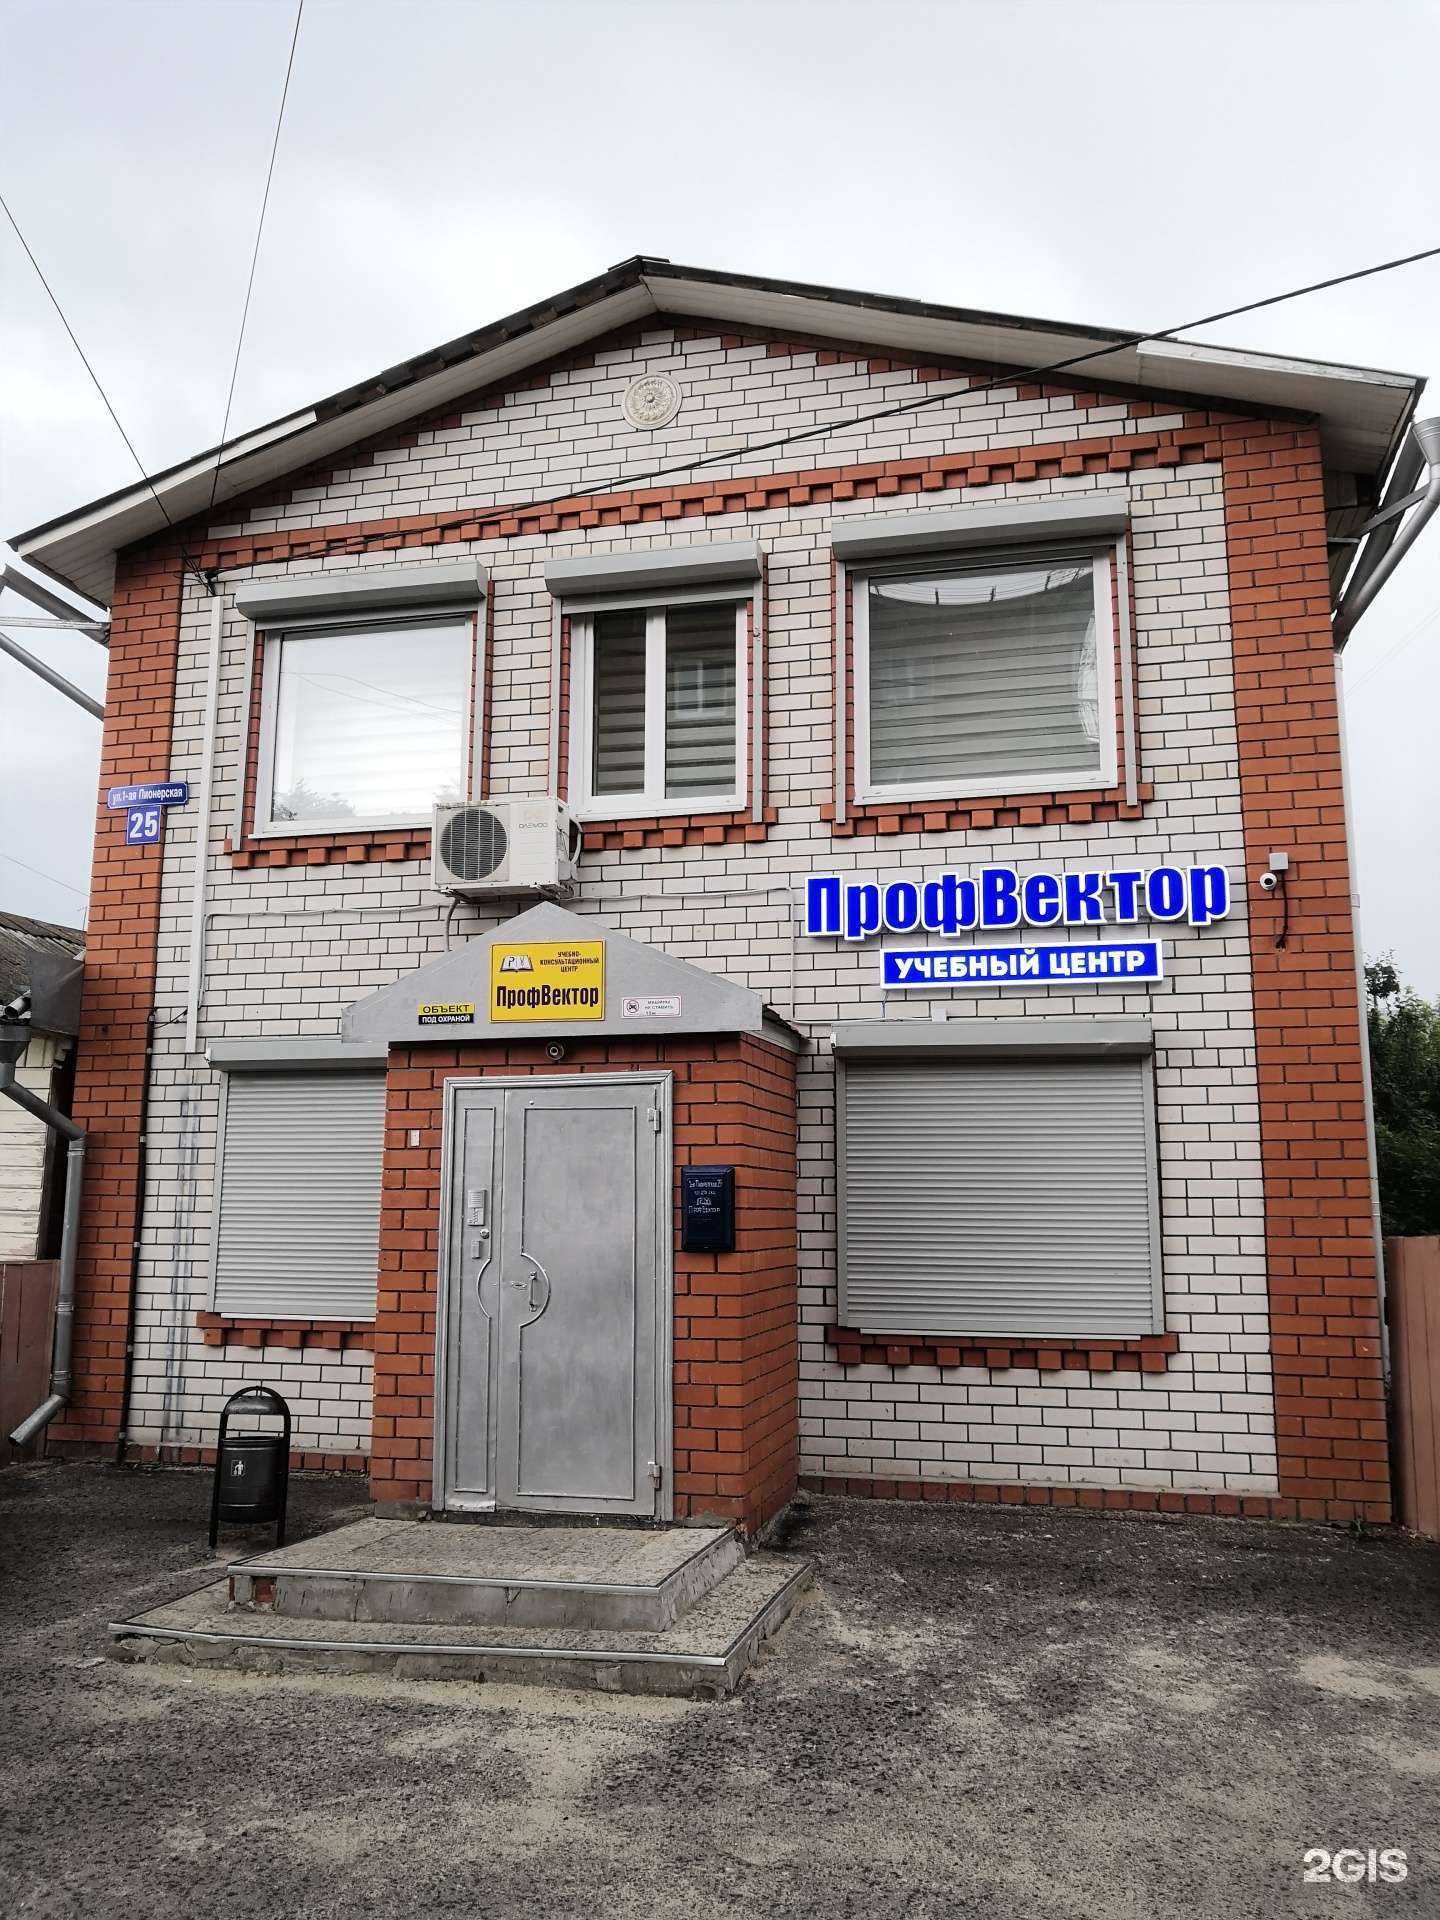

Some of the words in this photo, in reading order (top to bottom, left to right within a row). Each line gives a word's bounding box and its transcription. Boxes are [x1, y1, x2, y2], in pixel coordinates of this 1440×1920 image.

[138, 788, 183, 800] Пионерская
[129, 810, 158, 839] 25
[804, 863, 1231, 941] ПрофВектор
[540, 956, 599, 966] КОНСУЛЬТАЦИОННЫЙ
[894, 948, 1044, 979] УЧЕБНЫЙ
[1049, 950, 1146, 977] ЦЕНТР
[560, 965, 579, 973] ЦЕНТР
[496, 984, 599, 1010] ПрофВектор
[422, 1004, 470, 1014] ОБЪЕКТ
[422, 1016, 437, 1024] ПОД
[438, 1015, 470, 1023] ОХРАНОЙ
